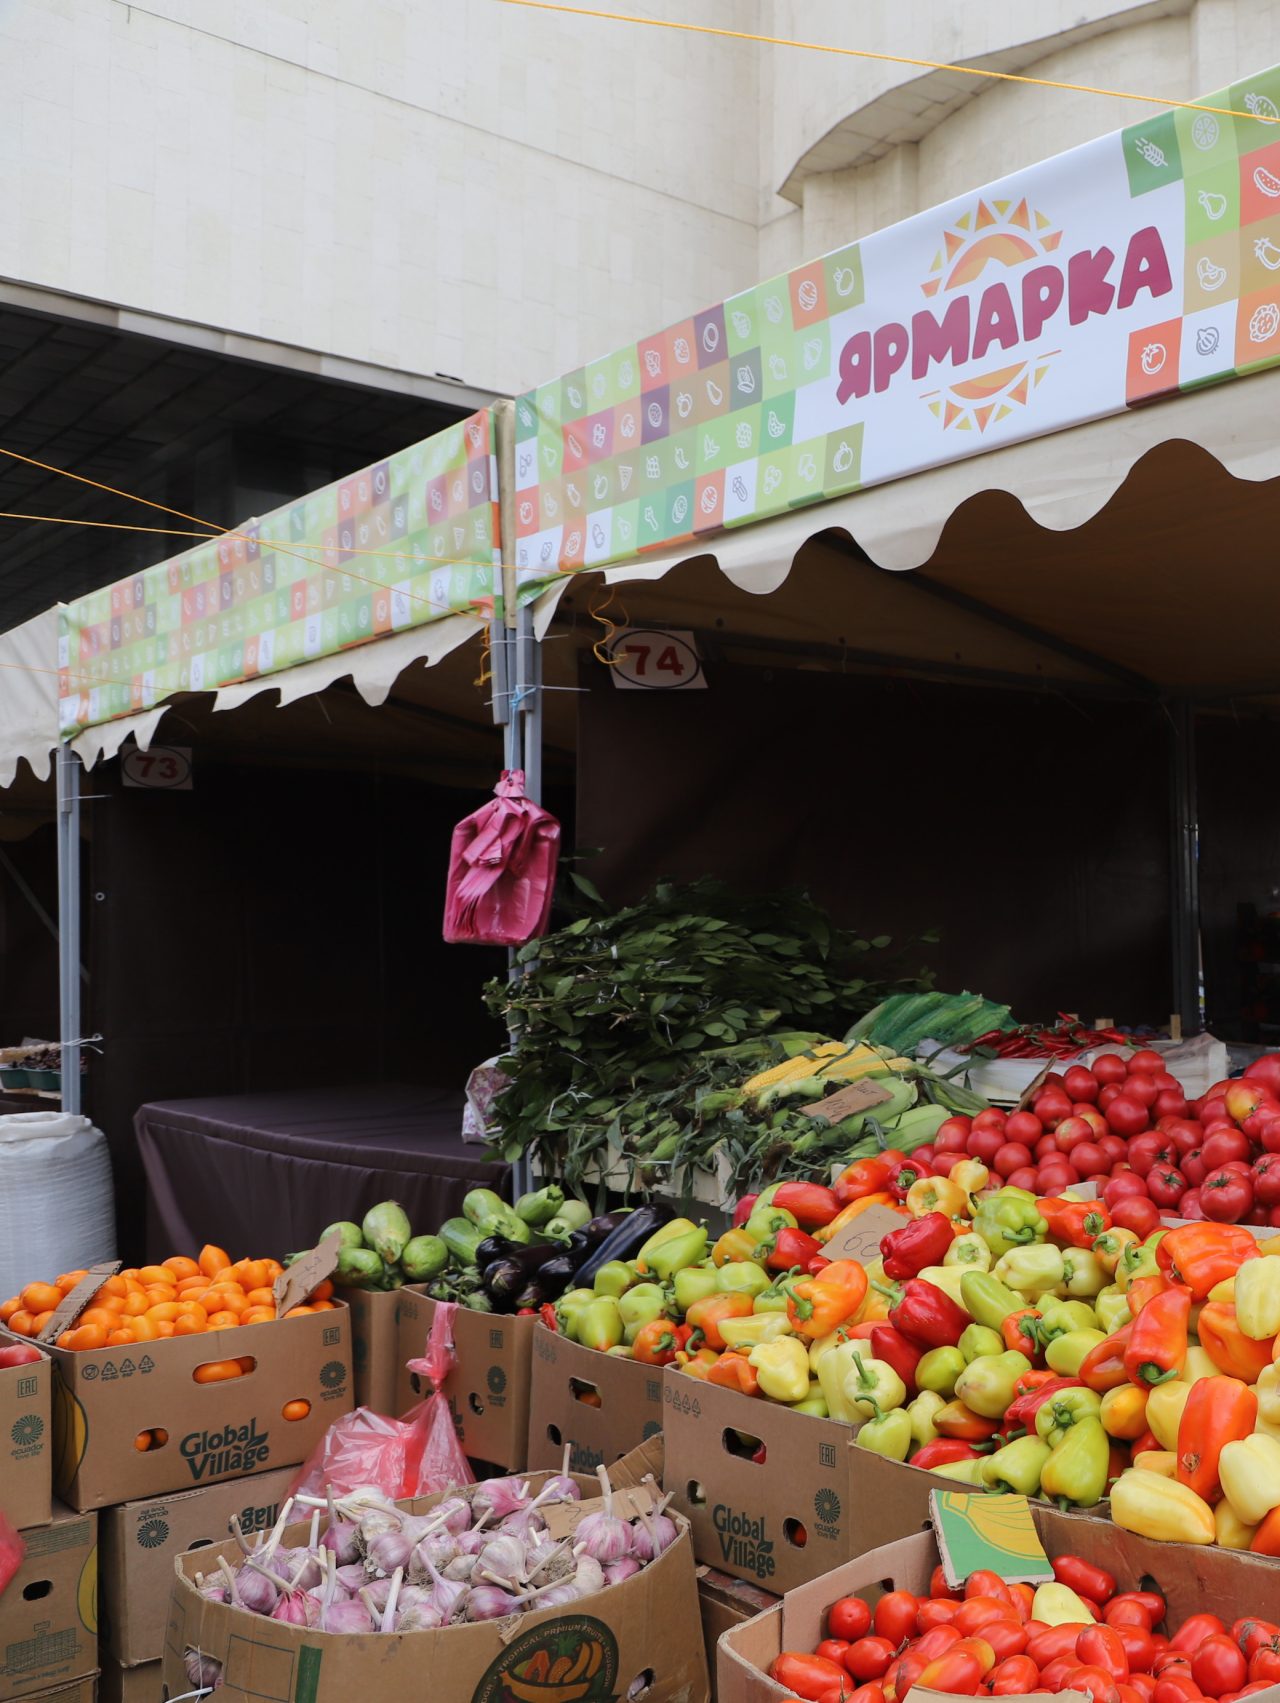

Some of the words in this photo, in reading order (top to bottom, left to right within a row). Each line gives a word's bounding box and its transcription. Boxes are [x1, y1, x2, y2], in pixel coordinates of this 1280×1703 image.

[836, 226, 1173, 405] ЯРМАРКА
[625, 645, 684, 675] 74
[136, 755, 178, 779] 73
[180, 1417, 266, 1457] Global
[186, 1445, 269, 1480] Village
[712, 1504, 769, 1546] Global
[718, 1533, 775, 1579] Village
[498, 1635, 541, 1672] TROPICAL
[543, 1624, 581, 1636] PREMIUM
